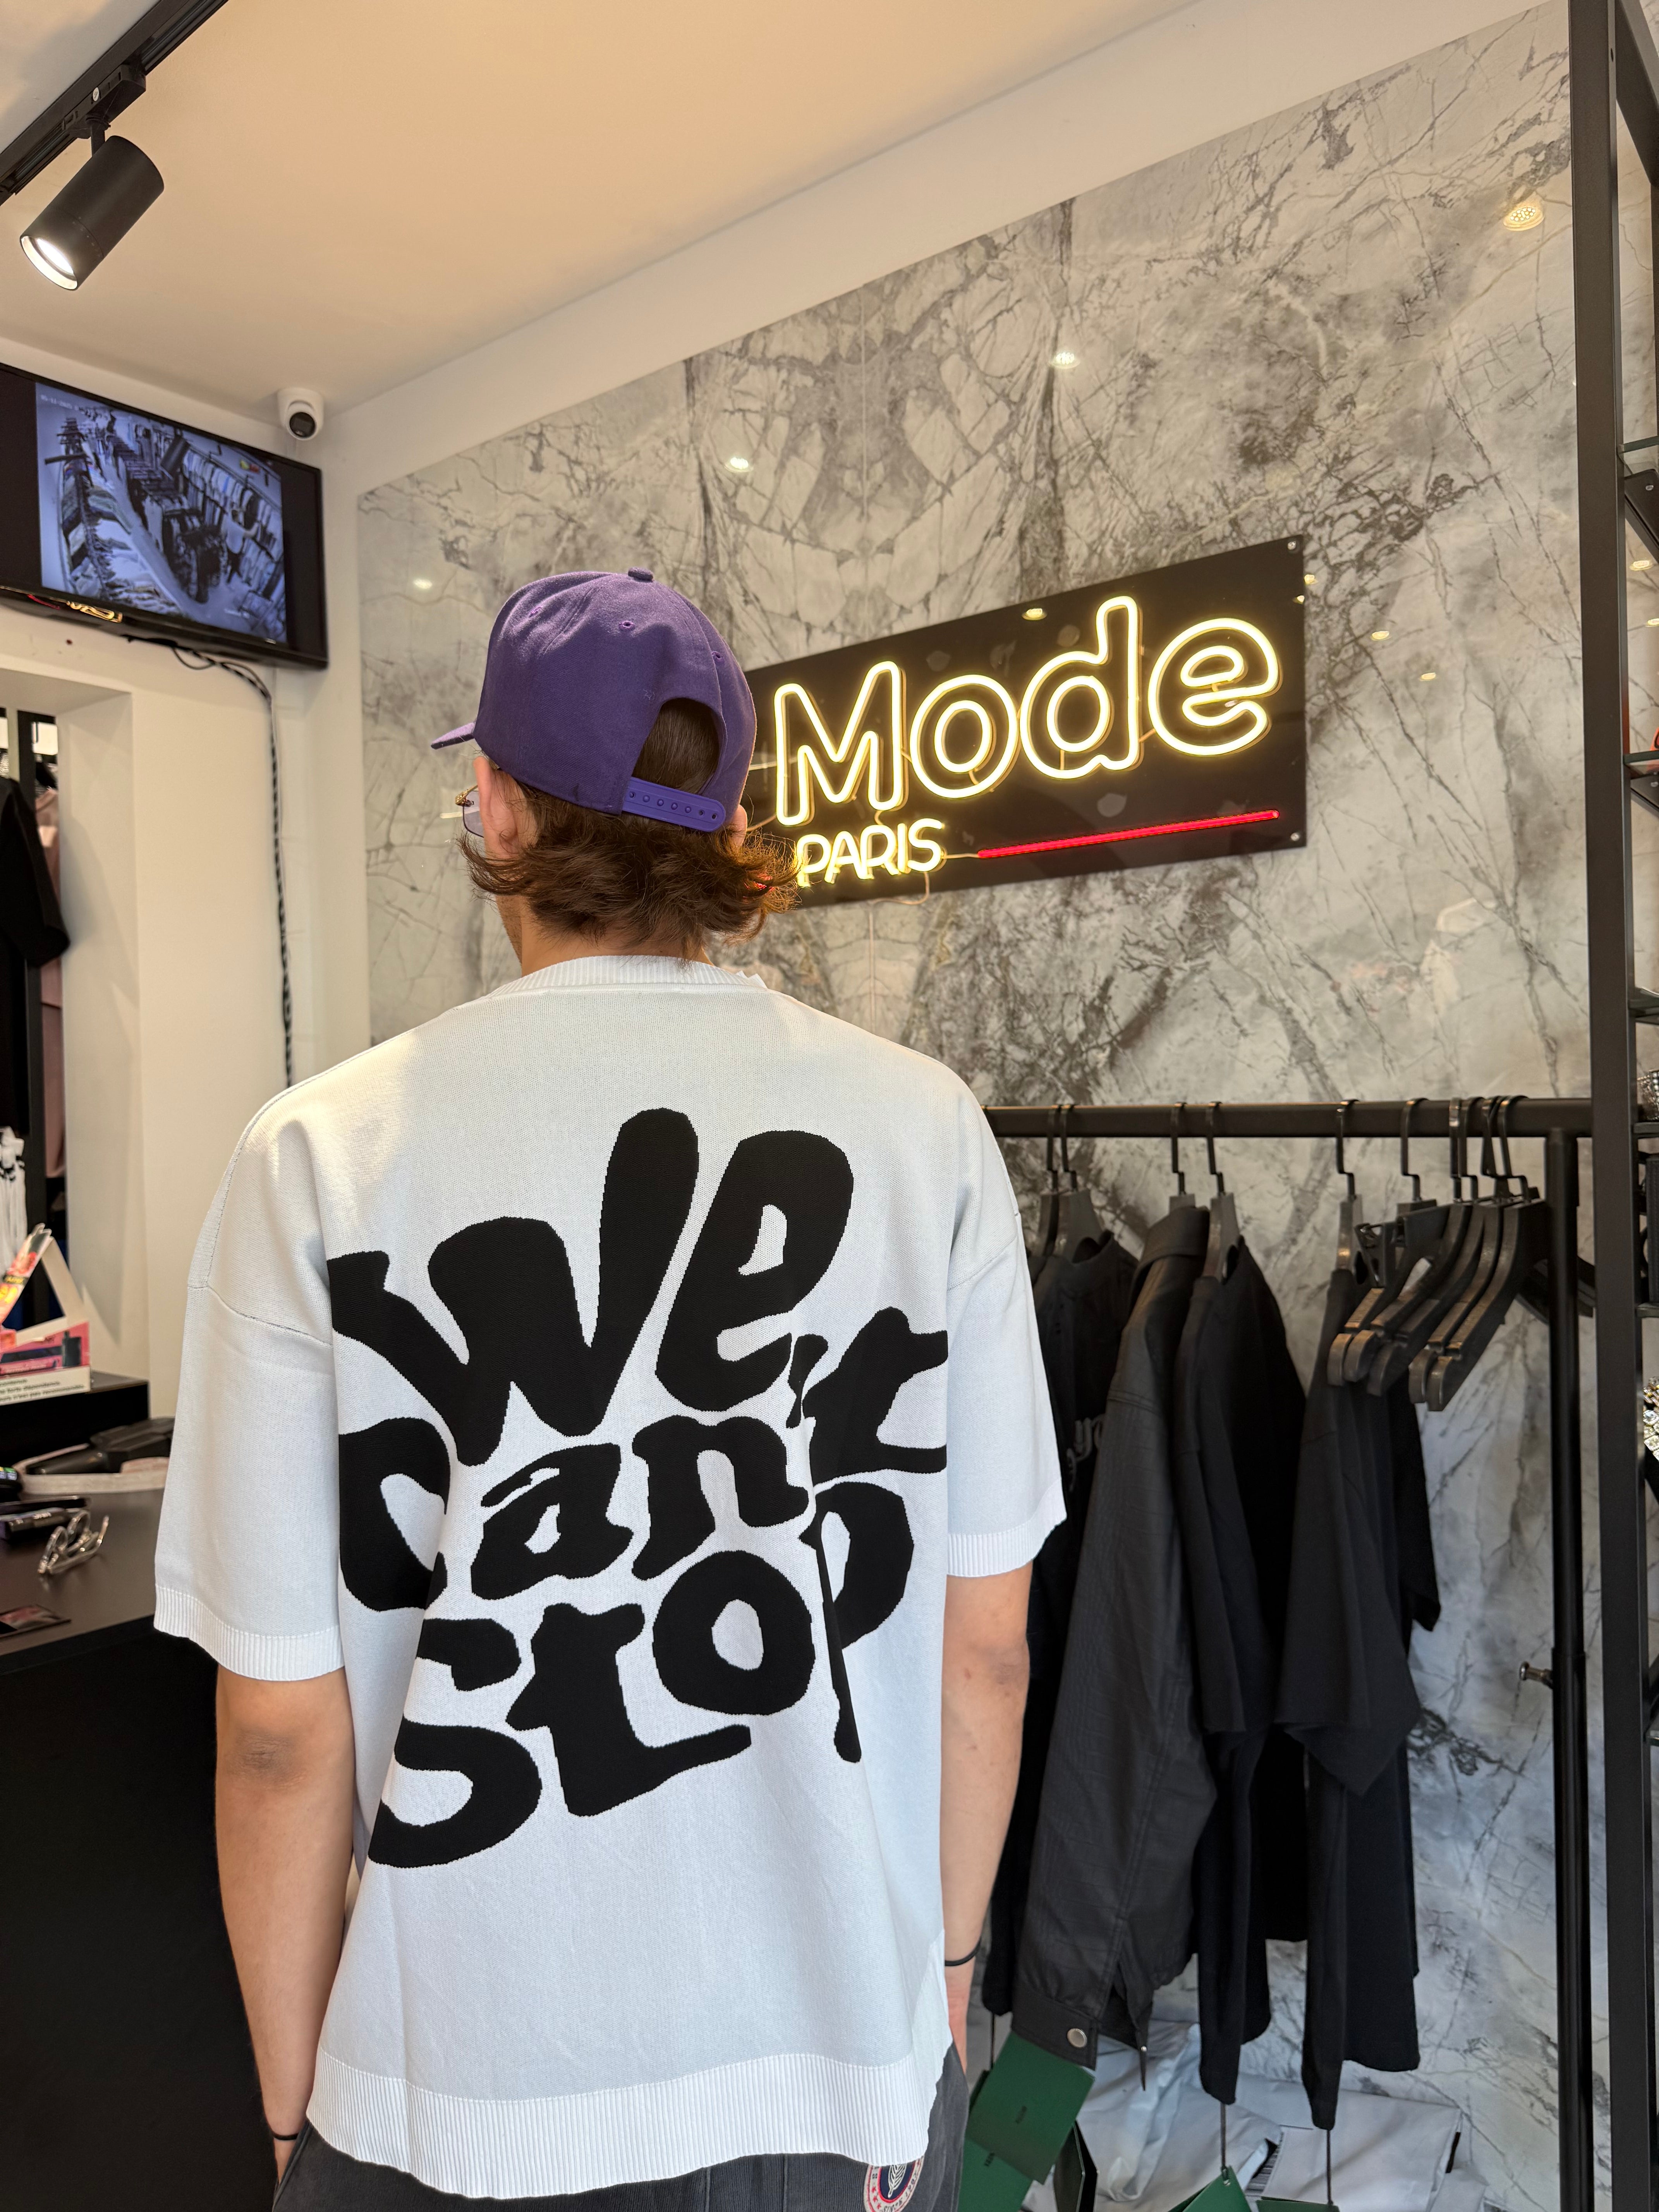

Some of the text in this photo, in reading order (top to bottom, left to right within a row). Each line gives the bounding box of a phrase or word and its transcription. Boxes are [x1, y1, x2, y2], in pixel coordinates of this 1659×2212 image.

[775, 595, 1281, 826] Mode
[796, 817, 945, 888] PARIS
[327, 1108, 853, 1466] We
